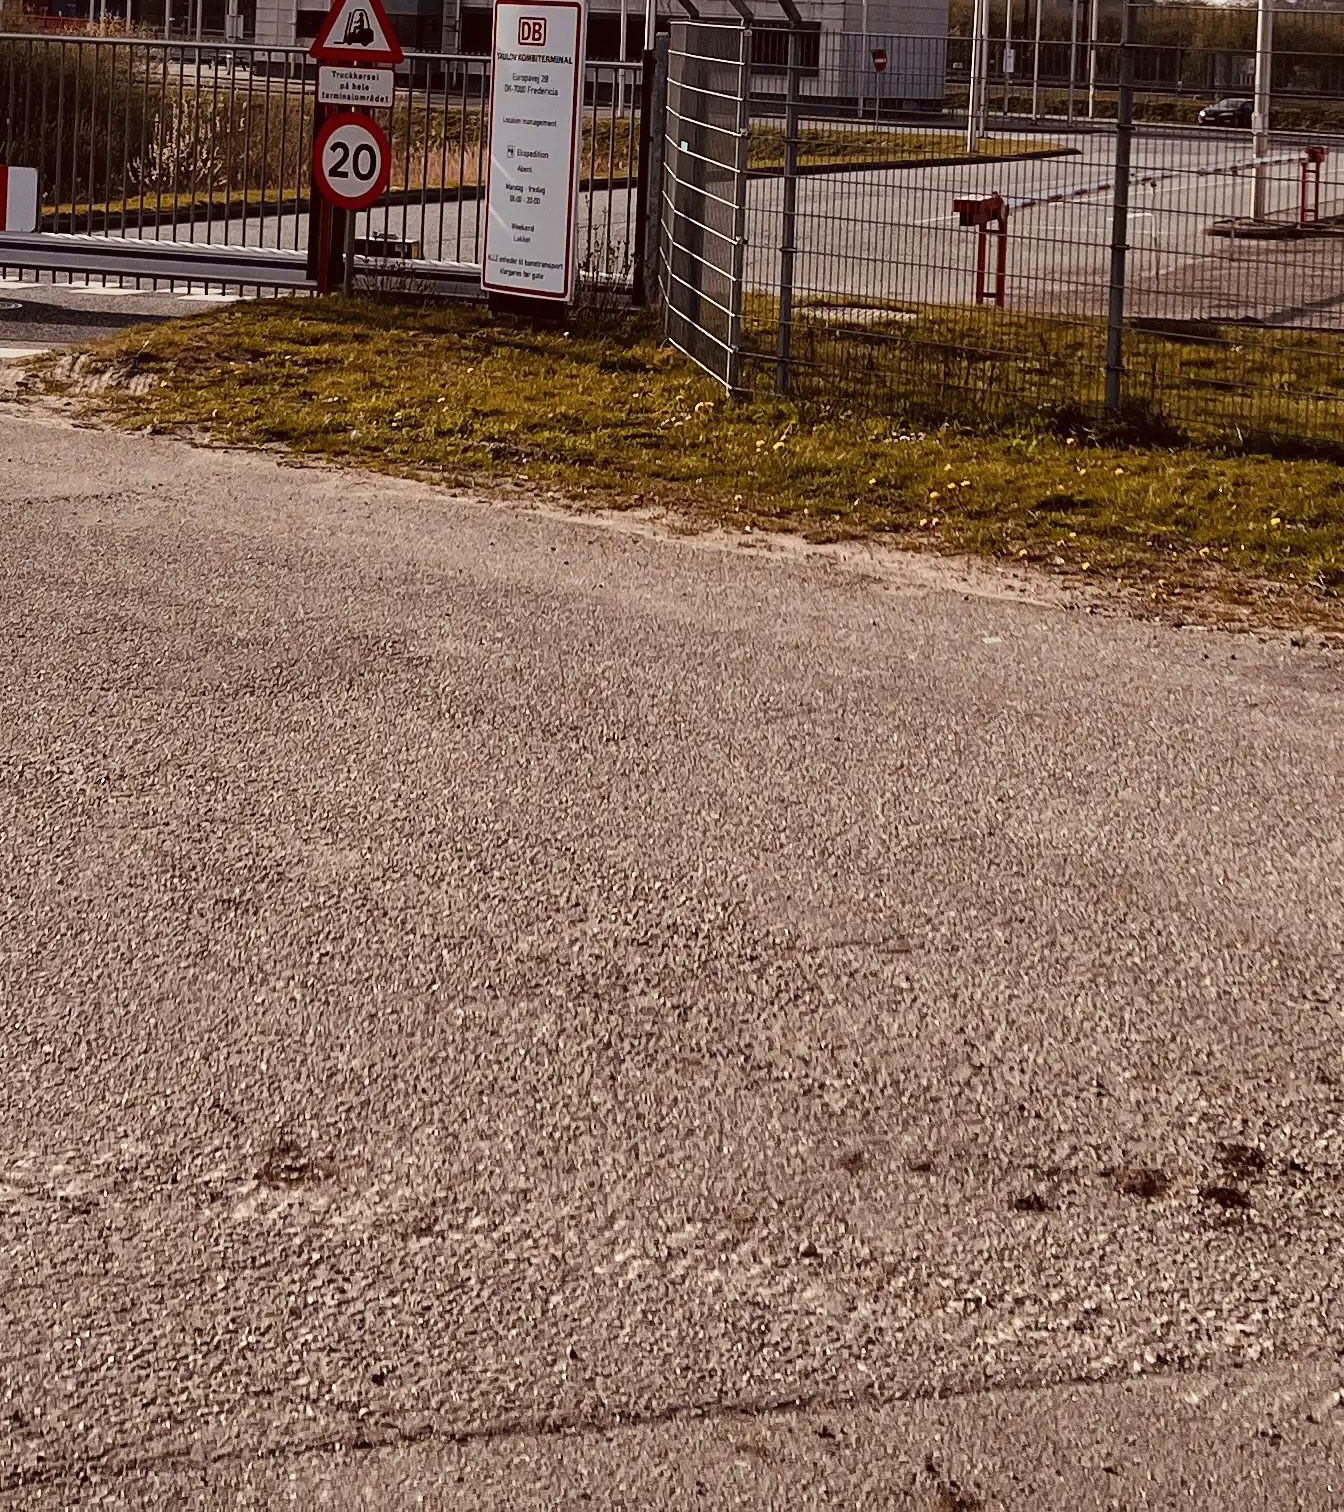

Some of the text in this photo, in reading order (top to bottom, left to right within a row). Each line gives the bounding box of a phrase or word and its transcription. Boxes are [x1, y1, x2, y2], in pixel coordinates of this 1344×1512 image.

[521, 21, 543, 42] DB
[518, 53, 573, 65] KOMBITERMINAL
[339, 82, 370, 92] på hele
[527, 85, 559, 96] Fredericia
[321, 91, 389, 103] terminalområdet
[522, 119, 557, 128] management
[328, 141, 377, 181] 20
